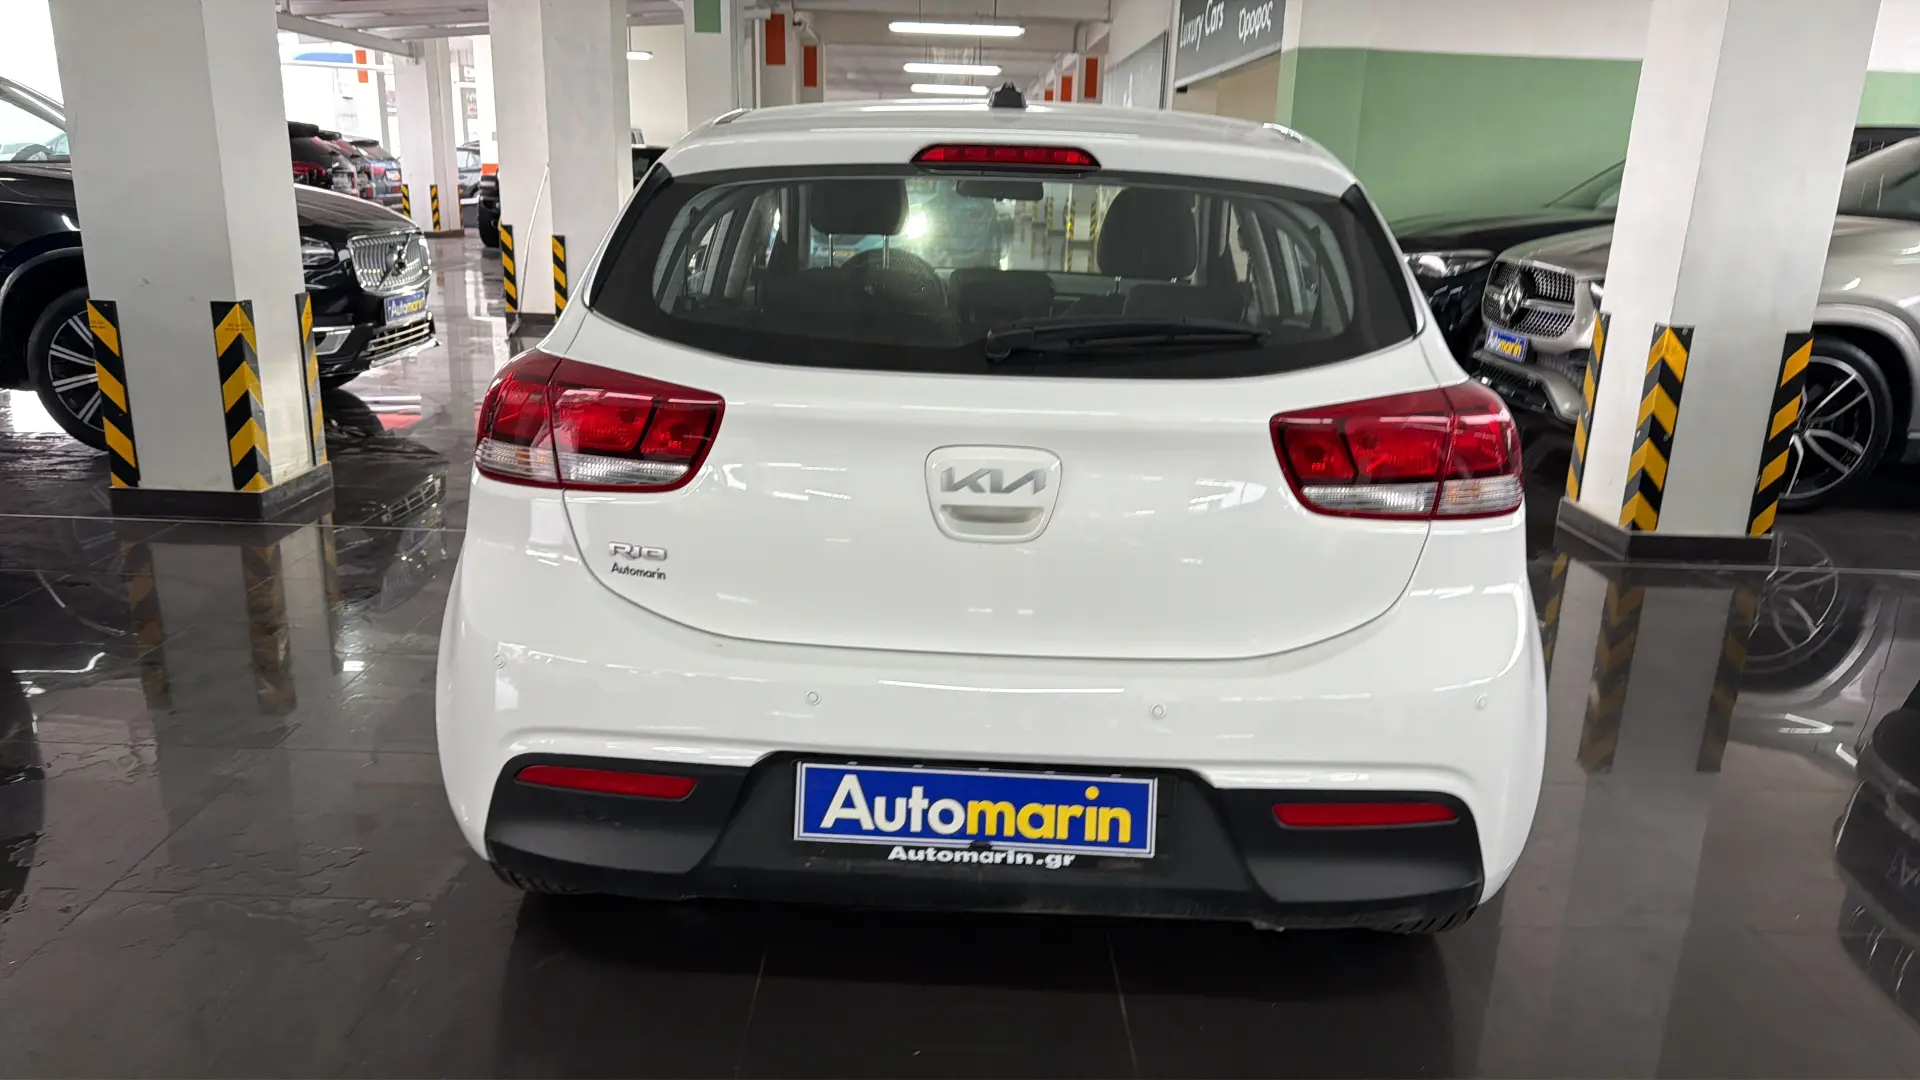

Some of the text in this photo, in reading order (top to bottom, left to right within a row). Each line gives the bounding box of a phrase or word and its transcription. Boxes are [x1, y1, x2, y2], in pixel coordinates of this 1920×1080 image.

[1180, 0, 1224, 52] Luxury Cars
[940, 466, 1047, 495] KIA
[608, 541, 668, 561] RIO
[820, 774, 1133, 843] Automarin
[888, 846, 1076, 869] Automarin.gr
